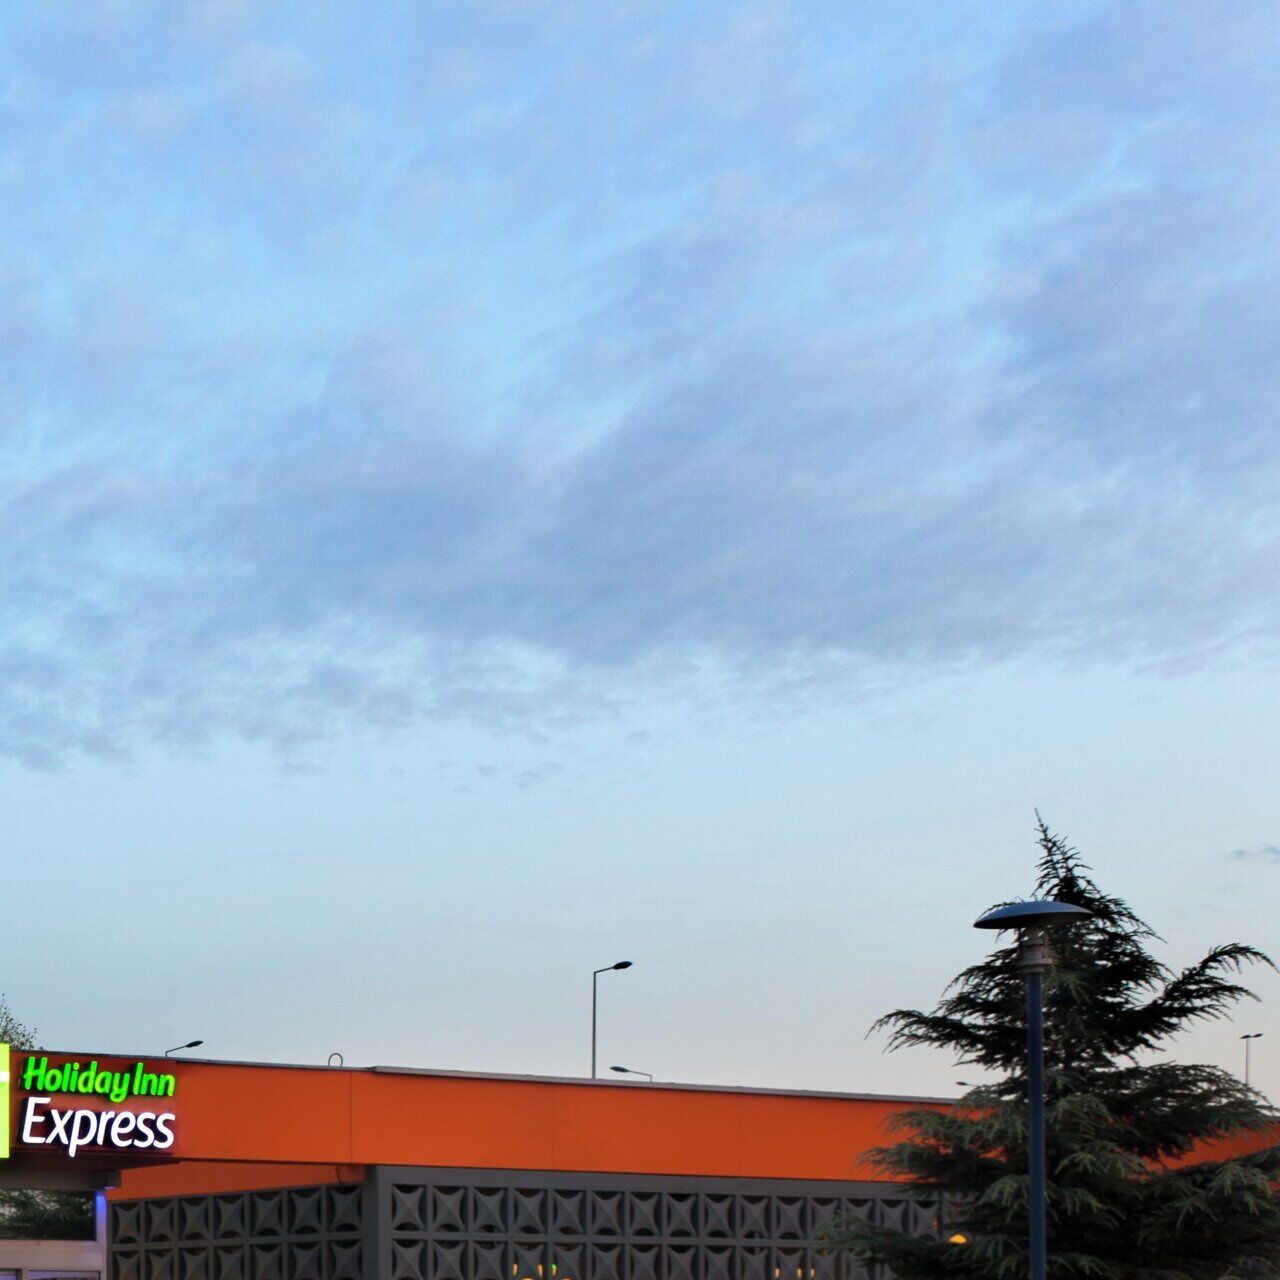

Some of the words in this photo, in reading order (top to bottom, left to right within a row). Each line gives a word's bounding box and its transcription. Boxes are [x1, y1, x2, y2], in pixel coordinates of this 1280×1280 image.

[23, 1056, 131, 1103] Holiday
[132, 1062, 176, 1097] Inn
[22, 1096, 176, 1158] Express
